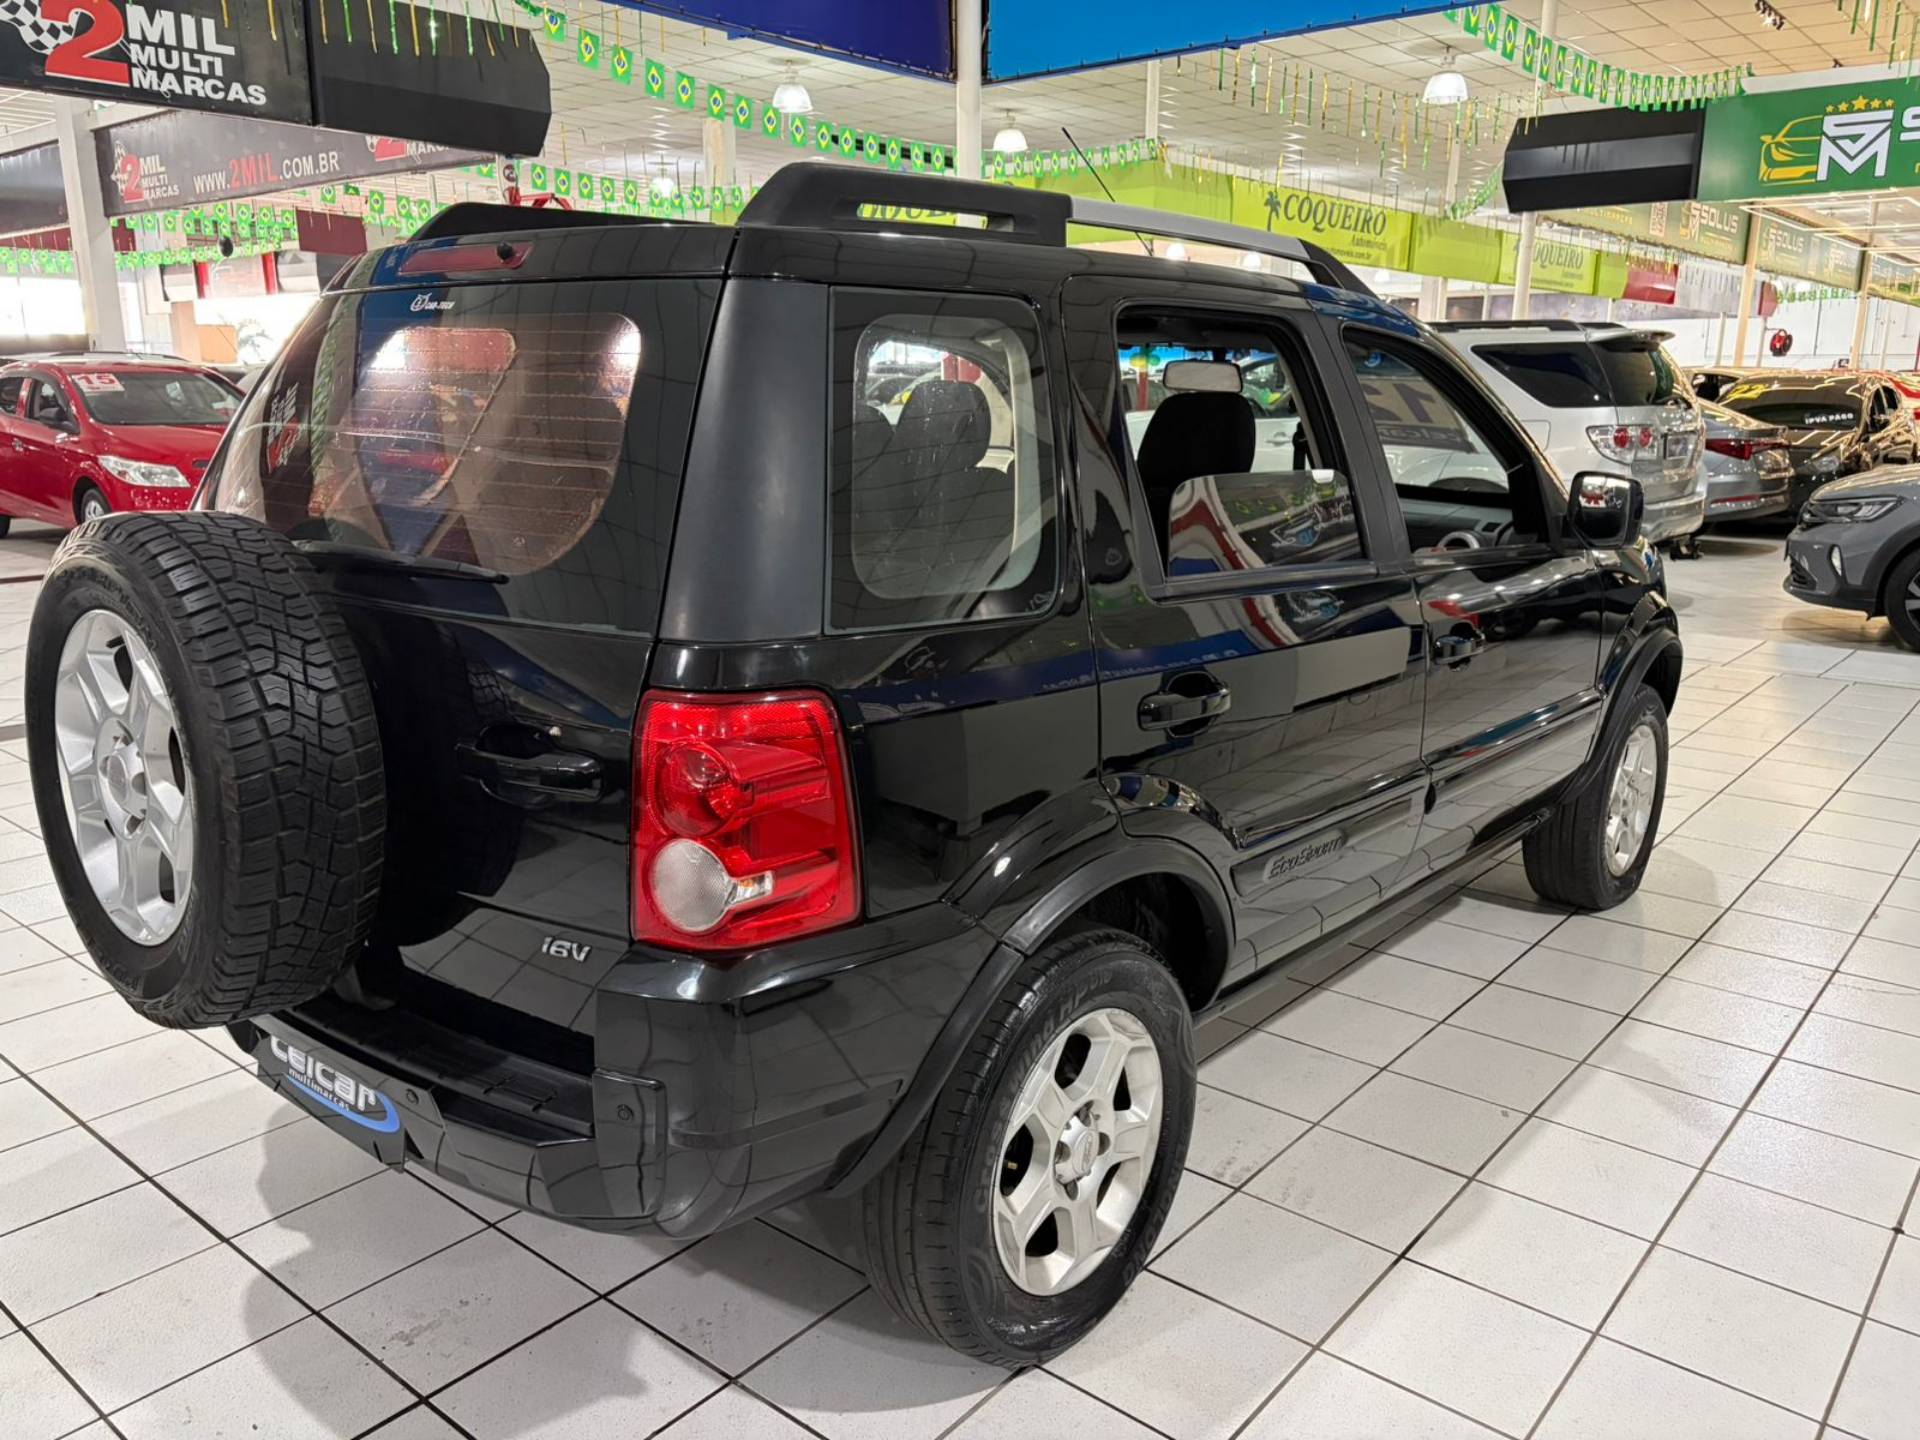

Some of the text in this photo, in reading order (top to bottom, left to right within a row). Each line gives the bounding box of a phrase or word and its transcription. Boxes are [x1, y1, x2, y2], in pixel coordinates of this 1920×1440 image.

[40, 0, 235, 87] 2 MIL
[129, 43, 224, 77] MULTI
[131, 67, 267, 106] MARCAS
[139, 155, 166, 175] MIL
[141, 173, 168, 187] MULTI
[142, 185, 180, 200] MARCAS
[1283, 193, 1387, 236] COQUEIRO
[1700, 205, 1739, 234] SOLUS
[542, 936, 592, 963] 16V
